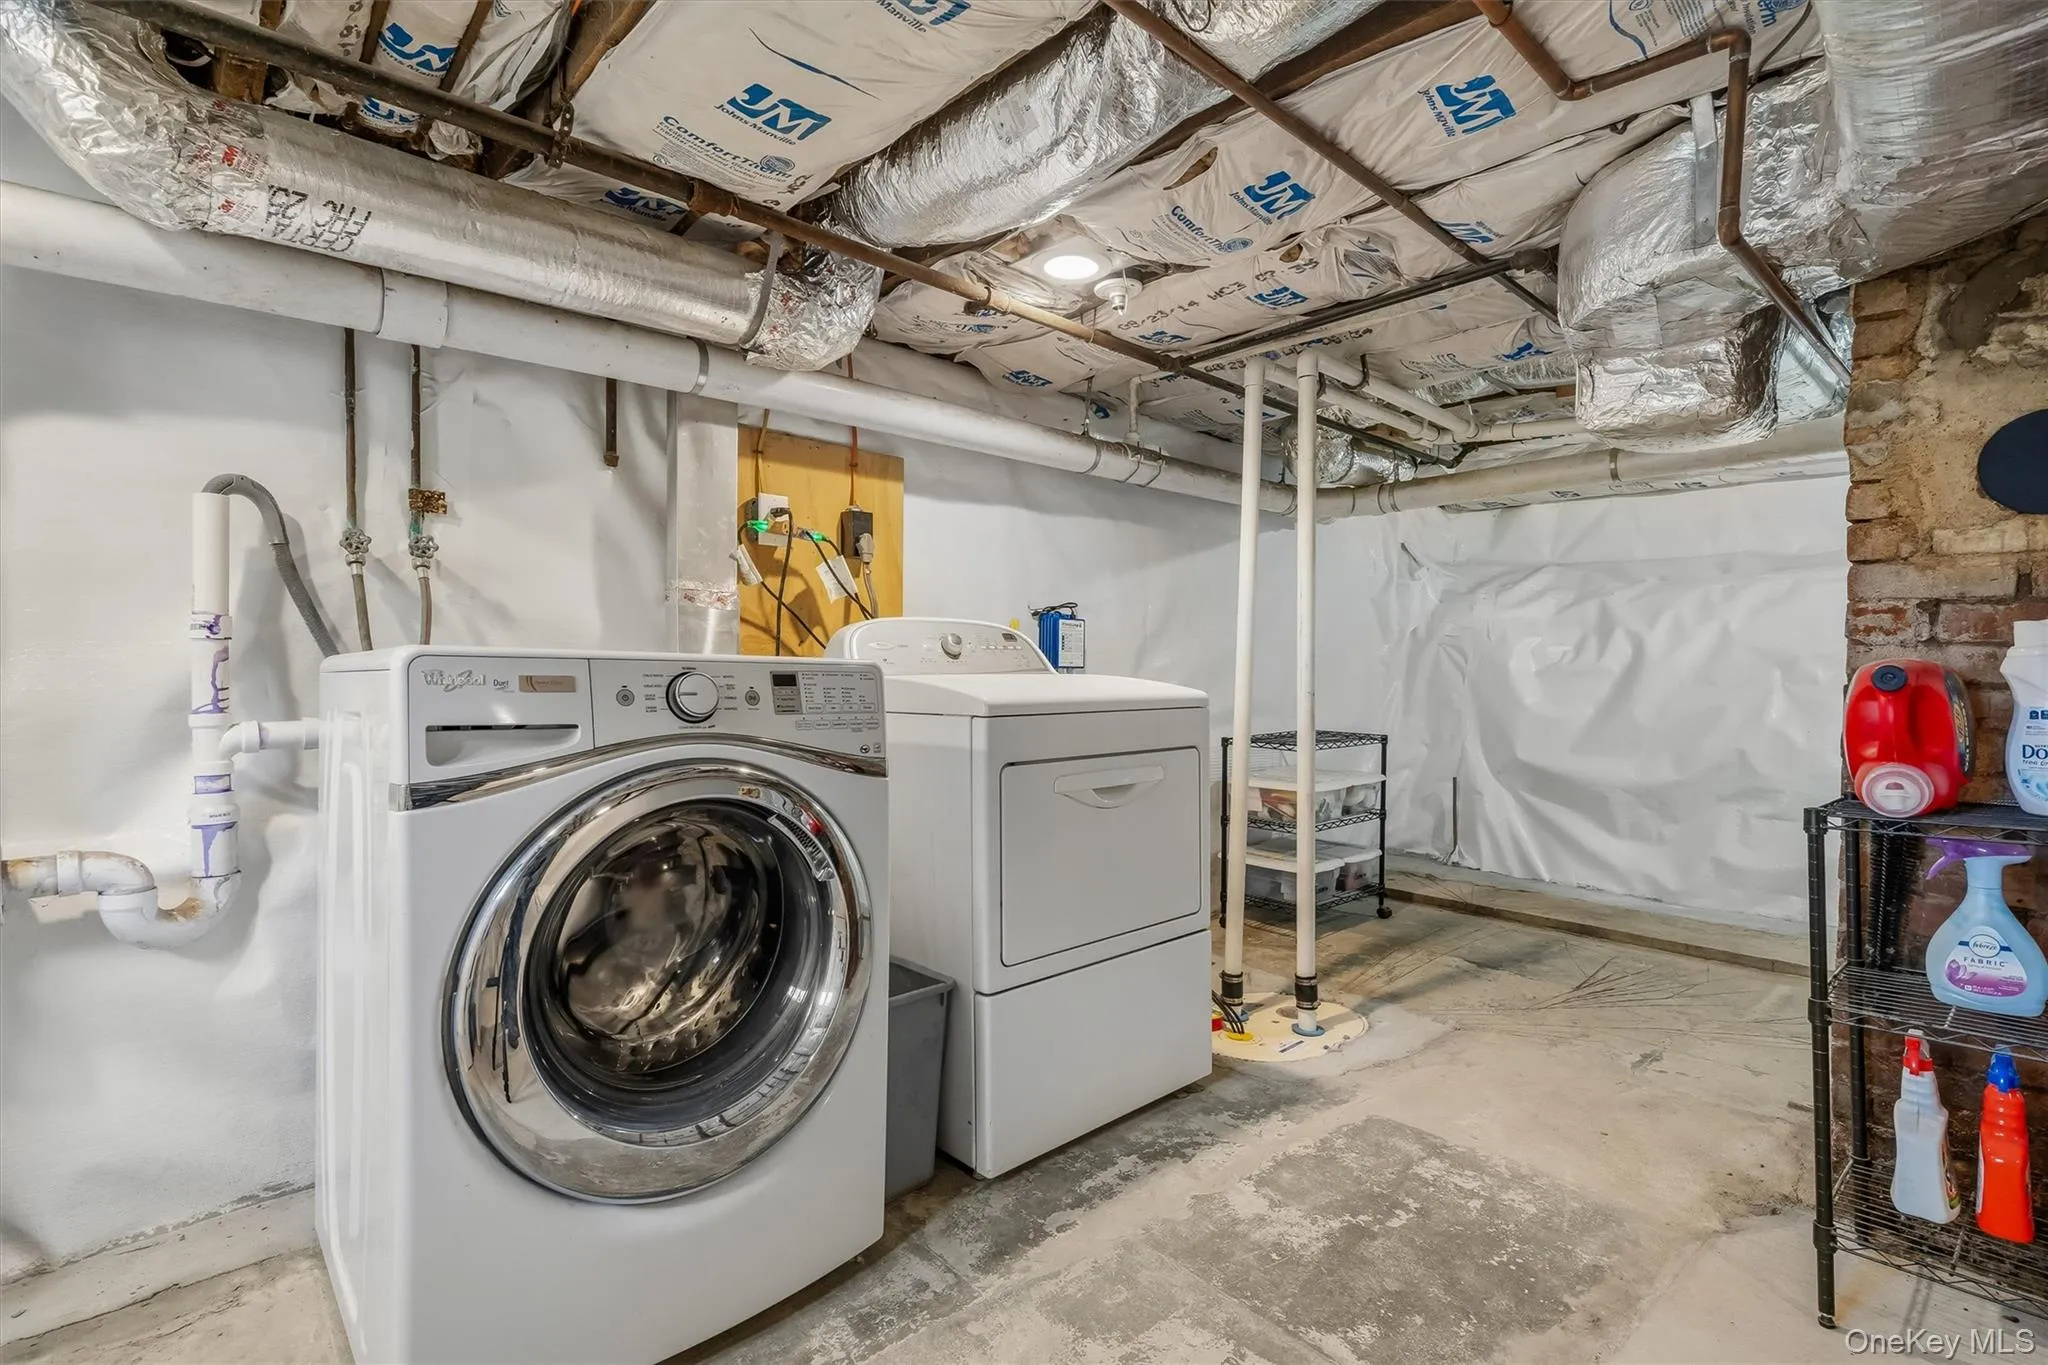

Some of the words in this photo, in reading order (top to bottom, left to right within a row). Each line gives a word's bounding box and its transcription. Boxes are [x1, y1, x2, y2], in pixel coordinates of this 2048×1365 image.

[713, 103, 751, 126] Johns
[749, 122, 798, 147] Manville
[726, 83, 832, 141] JM
[1435, 75, 1517, 134] JM
[662, 116, 794, 180] ComfortTherm
[1244, 171, 1316, 220] JM
[1963, 957, 2006, 967] FABRIC
